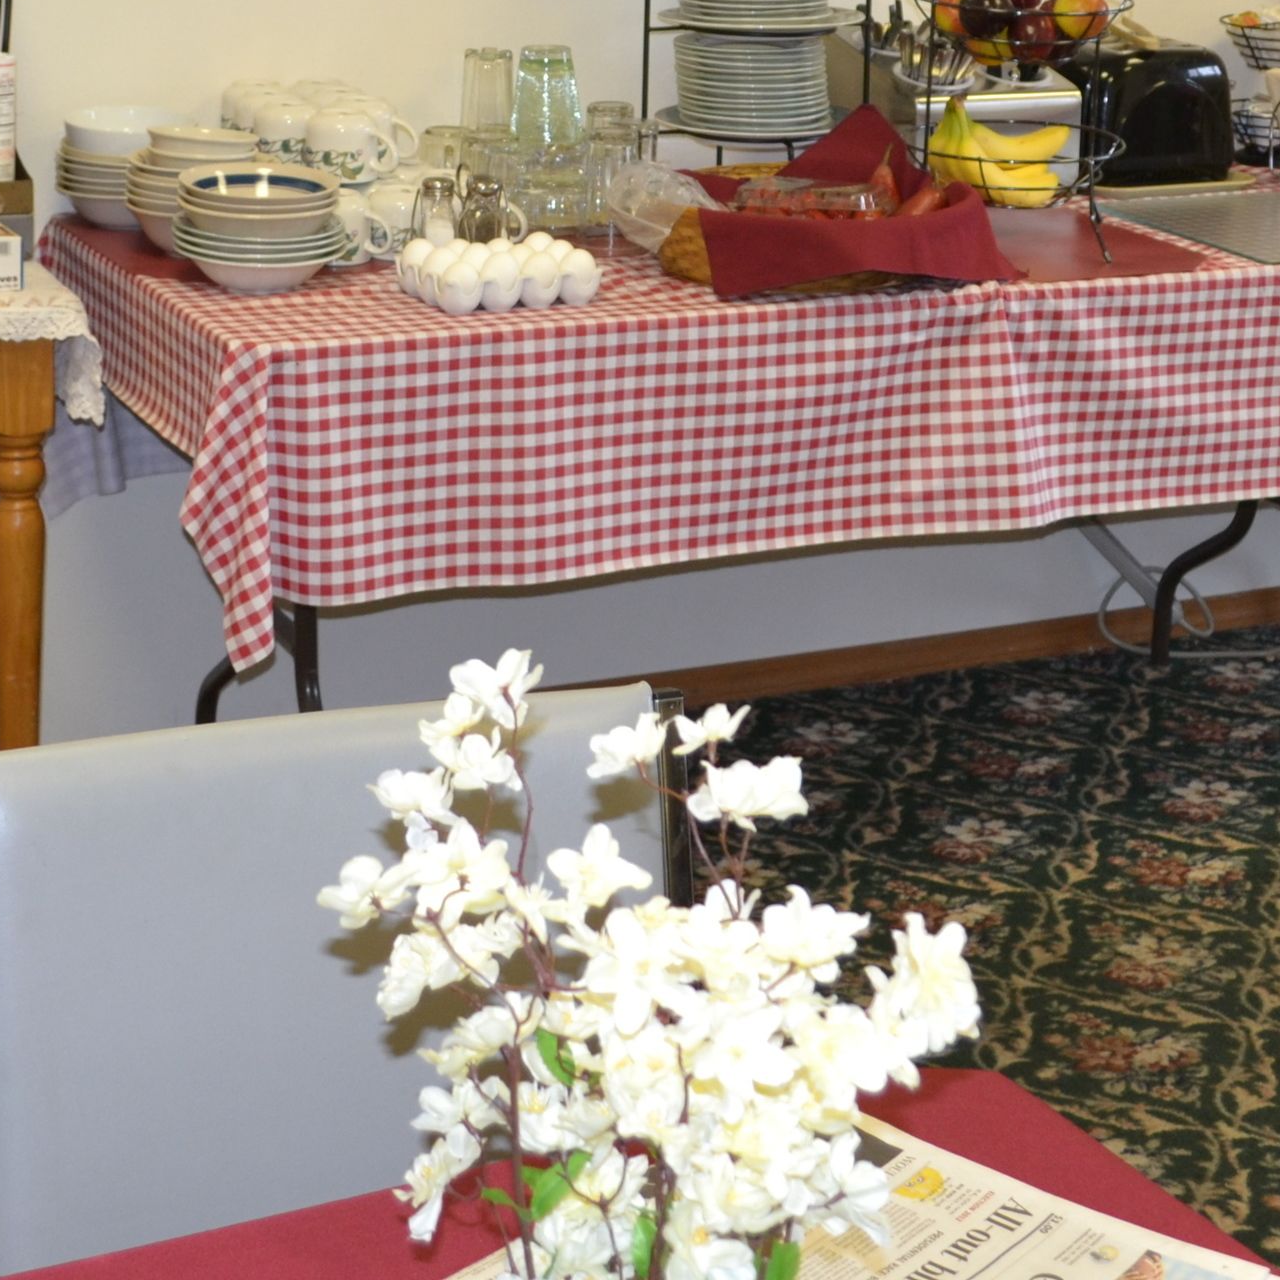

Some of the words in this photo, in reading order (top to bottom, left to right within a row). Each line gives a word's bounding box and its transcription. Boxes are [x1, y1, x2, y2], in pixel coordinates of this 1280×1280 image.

[941, 1196, 1034, 1263] All-out
[1039, 1215, 1064, 1235] $1.00
[897, 1230, 945, 1265] PRESIDENTIAL
